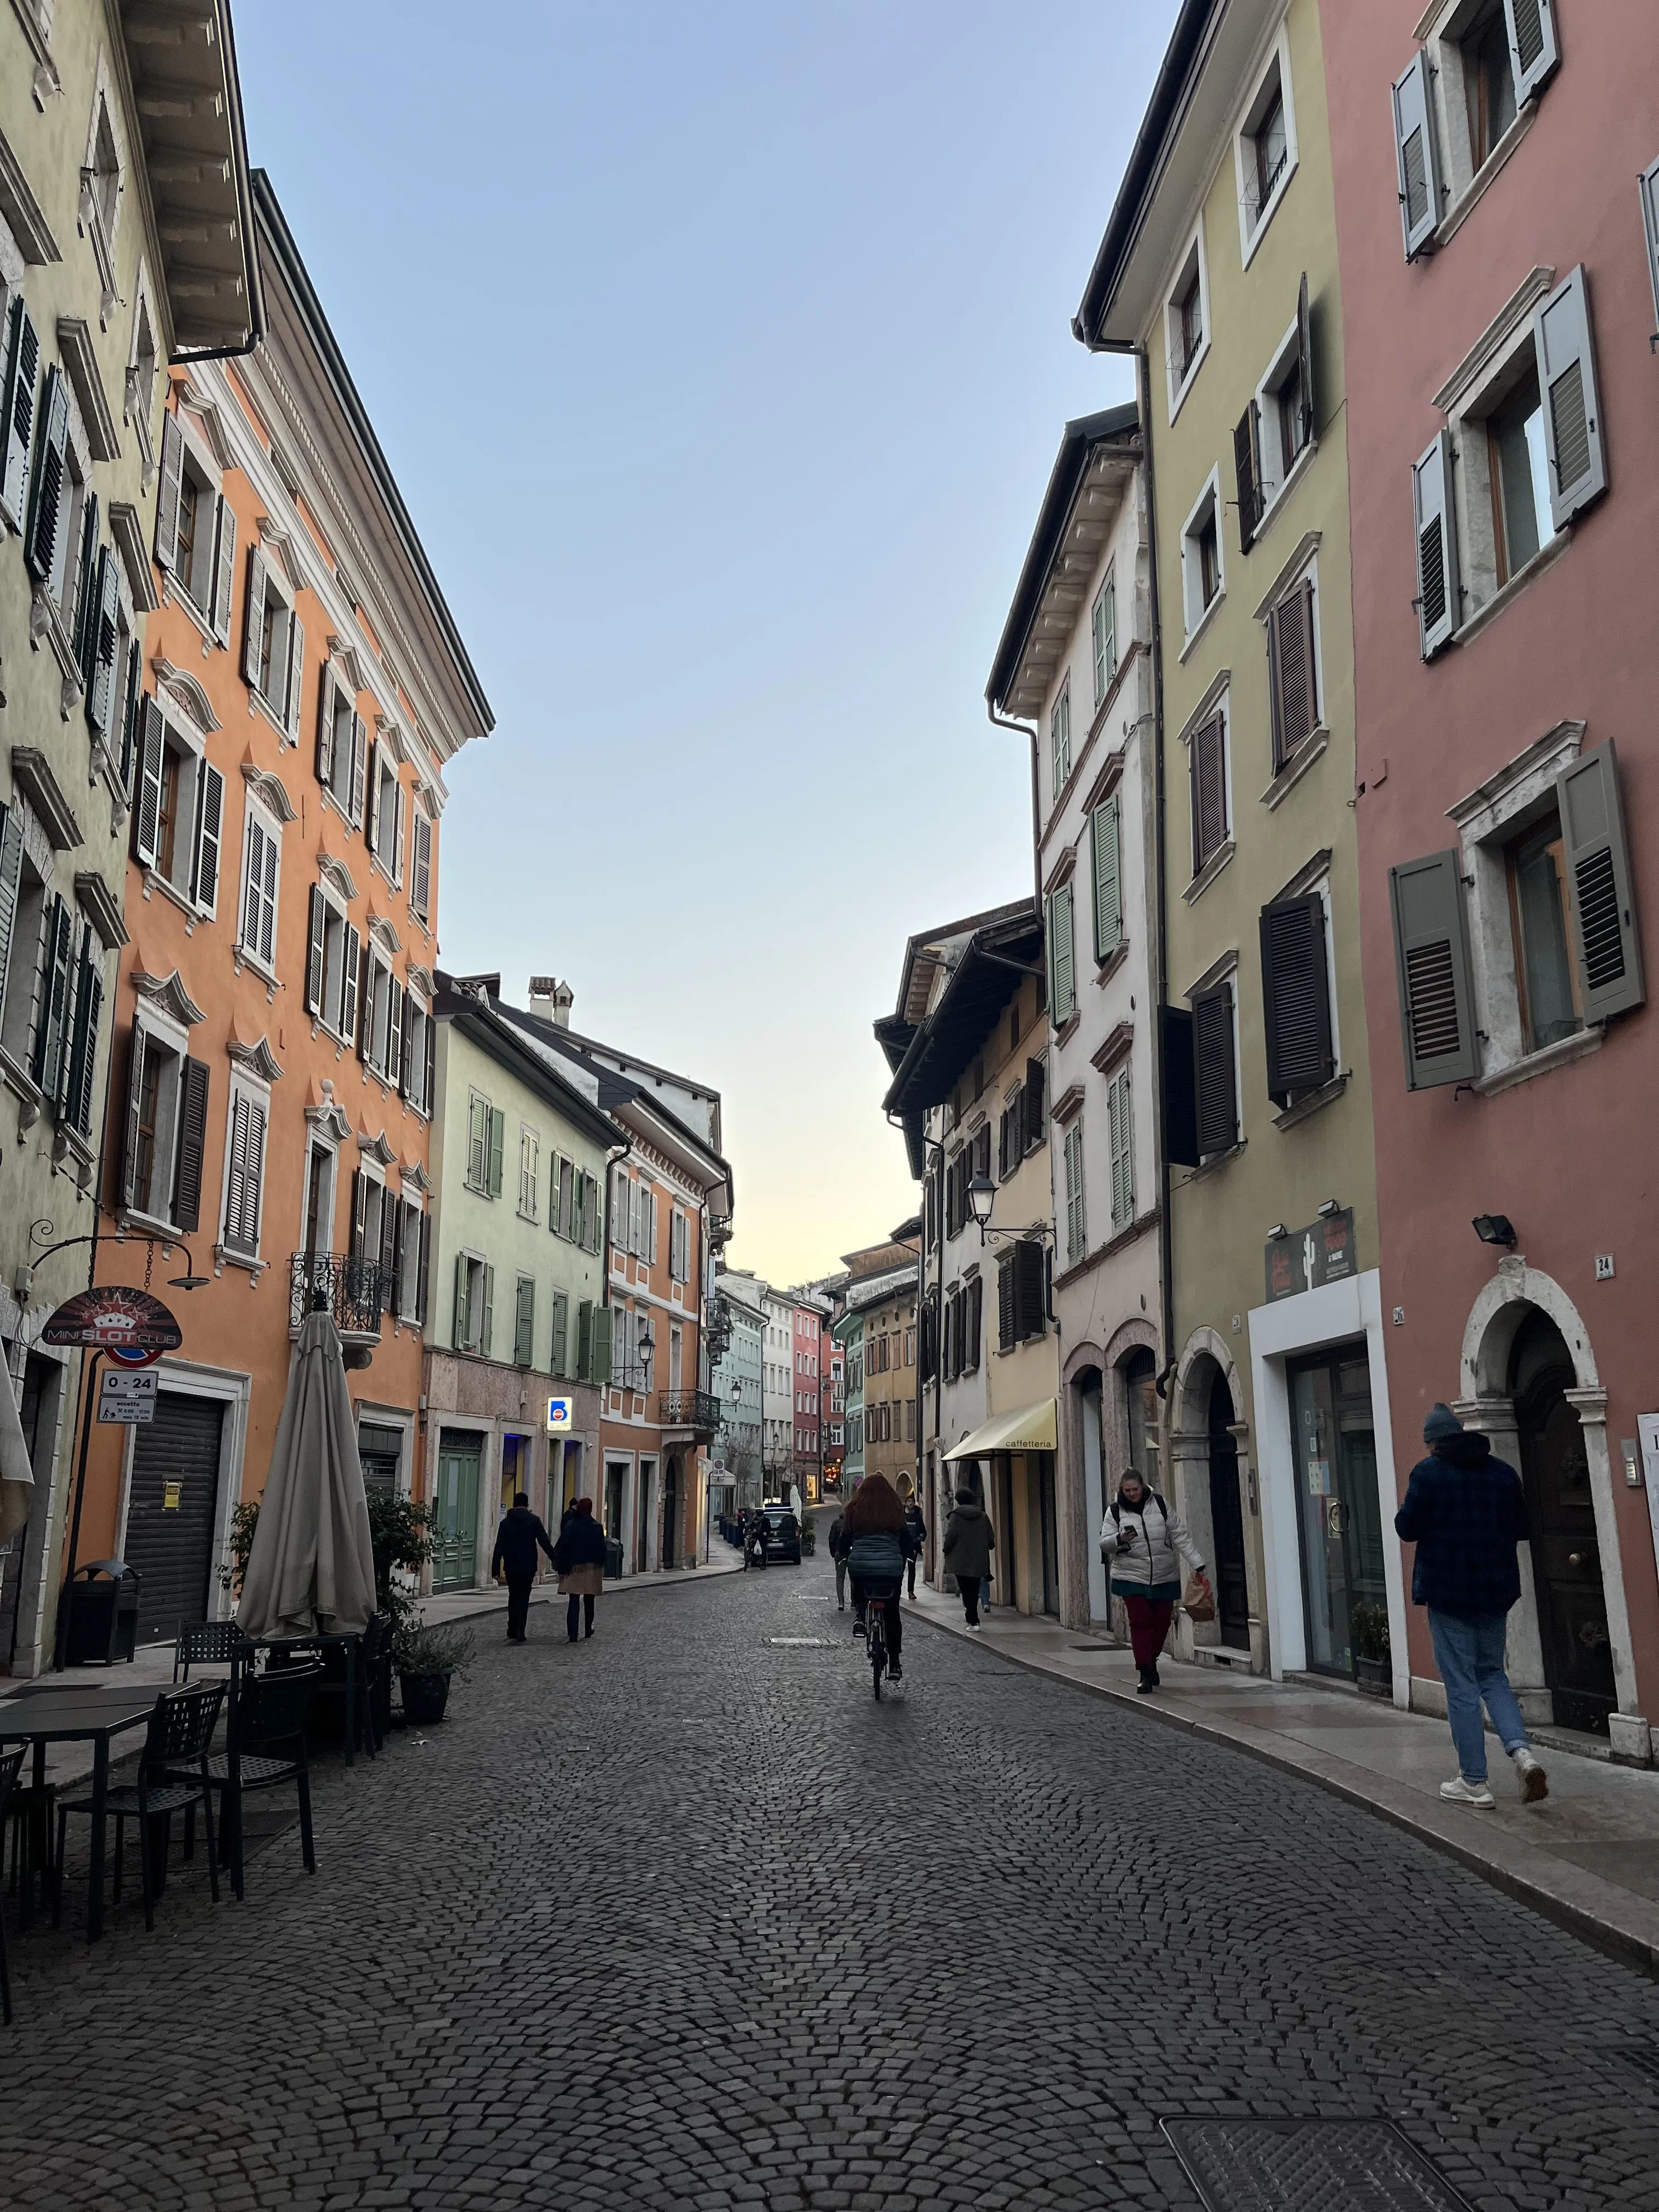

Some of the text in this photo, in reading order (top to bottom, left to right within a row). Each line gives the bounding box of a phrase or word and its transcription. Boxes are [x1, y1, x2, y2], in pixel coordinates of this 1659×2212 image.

[1599, 1257, 1609, 1271] 24
[47, 1329, 176, 1344] MINI SLOT CLUB
[108, 1376, 119, 1388] 0
[132, 1378, 151, 1389] 24
[1005, 1440, 1052, 1448] caffetteria
